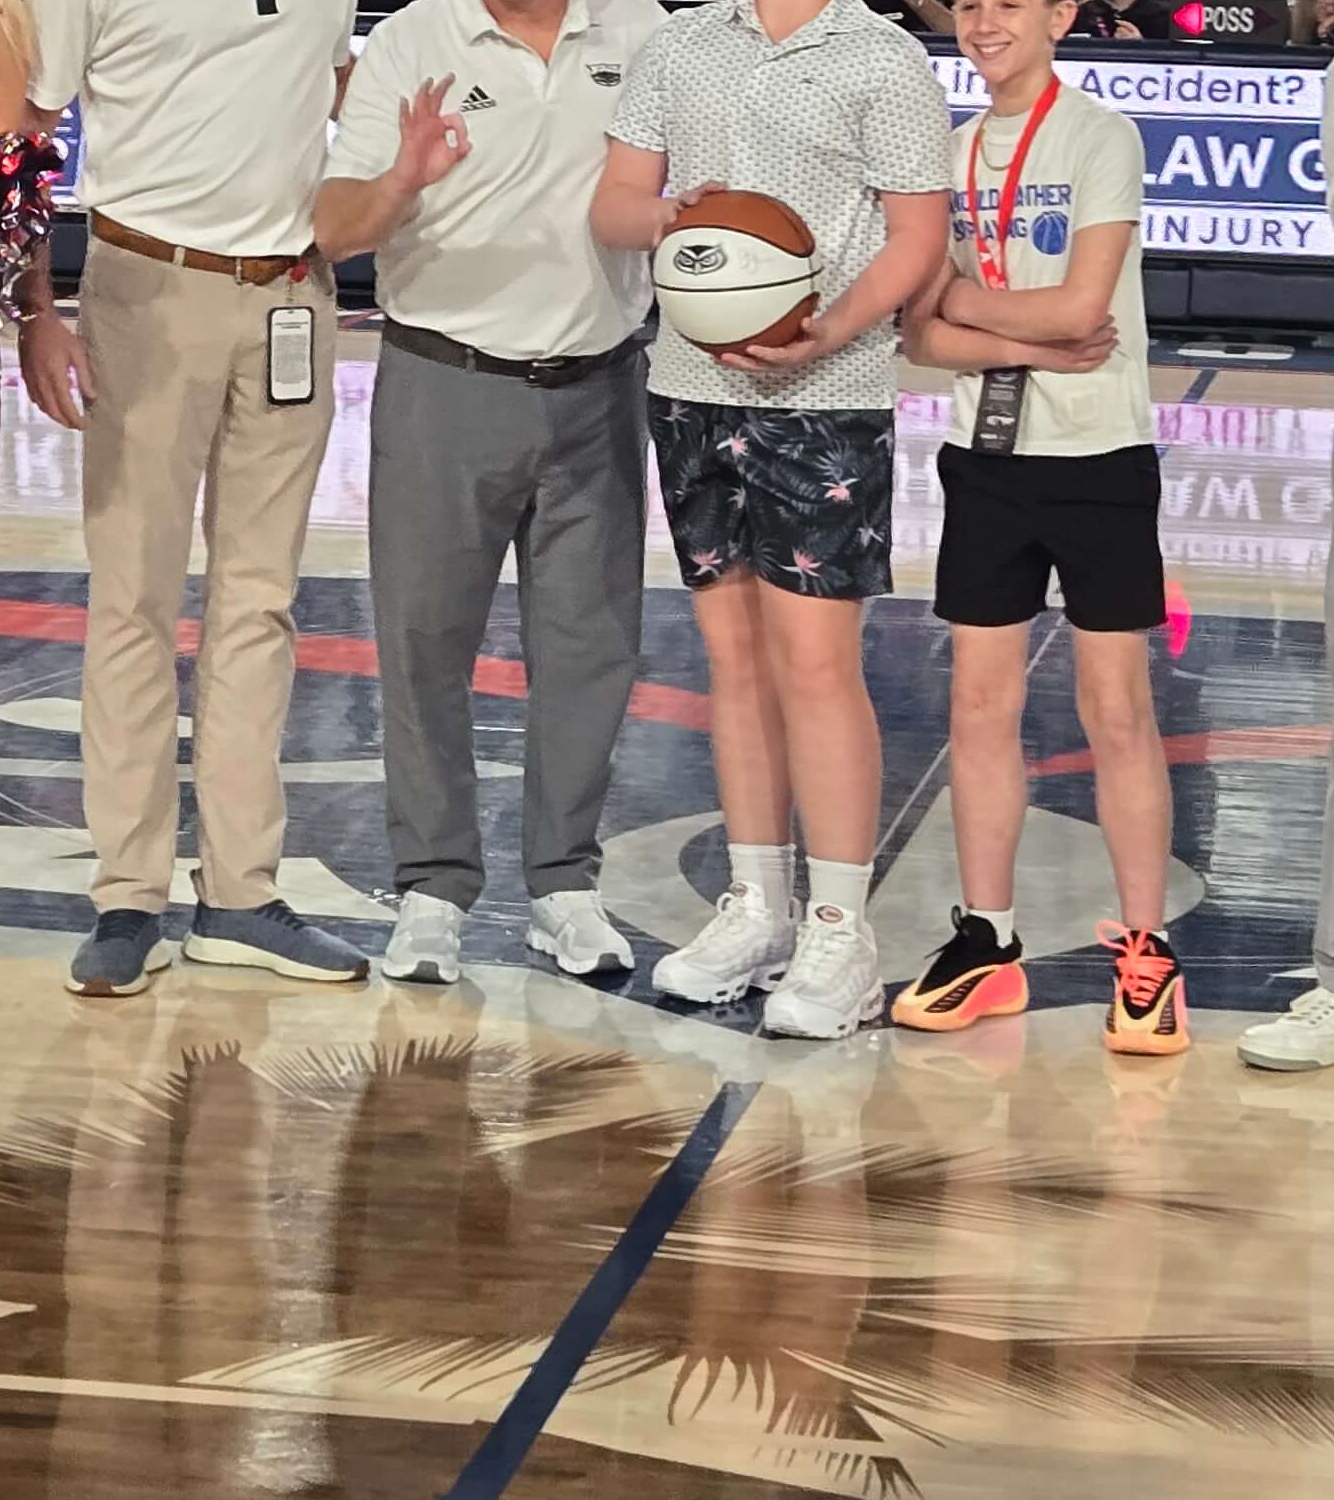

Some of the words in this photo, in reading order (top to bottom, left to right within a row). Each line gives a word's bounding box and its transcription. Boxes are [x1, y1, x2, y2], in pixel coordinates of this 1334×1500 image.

[1203, 6, 1255, 34] POSS
[1080, 67, 1305, 107] Accident?
[1145, 213, 1315, 247] INJURY
